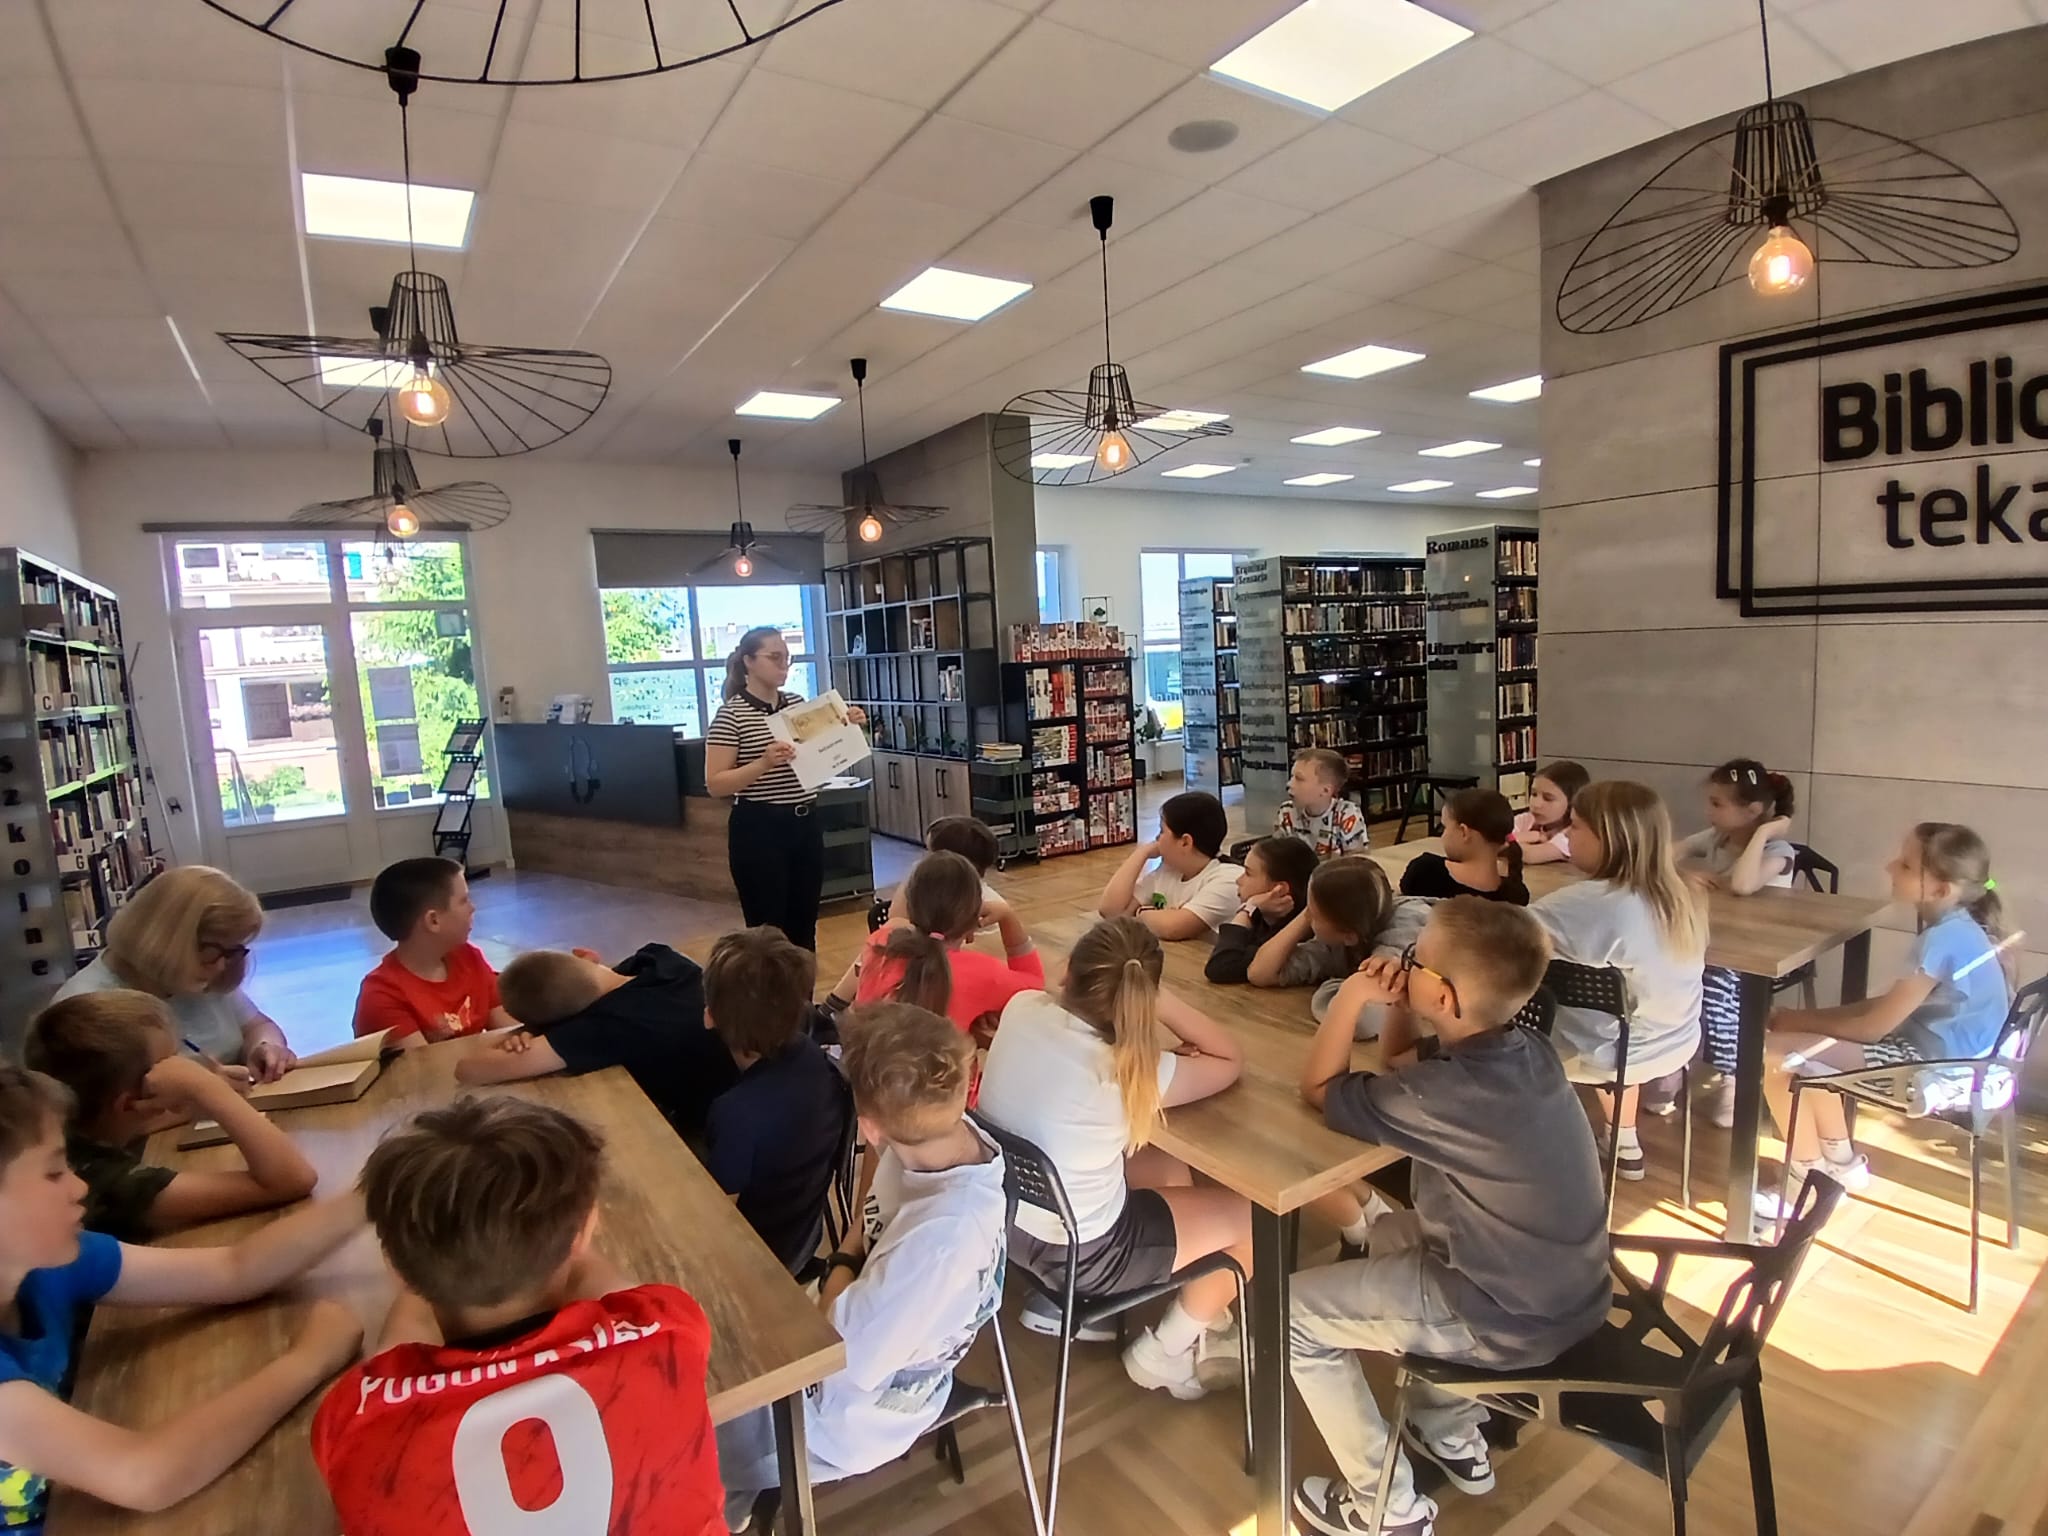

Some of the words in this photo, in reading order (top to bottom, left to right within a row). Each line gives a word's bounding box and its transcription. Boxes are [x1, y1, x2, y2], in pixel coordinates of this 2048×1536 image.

[1427, 537, 1489, 554] Romans
[42, 695, 52, 711] C
[76, 855, 84, 870] G
[88, 933, 98, 946] K
